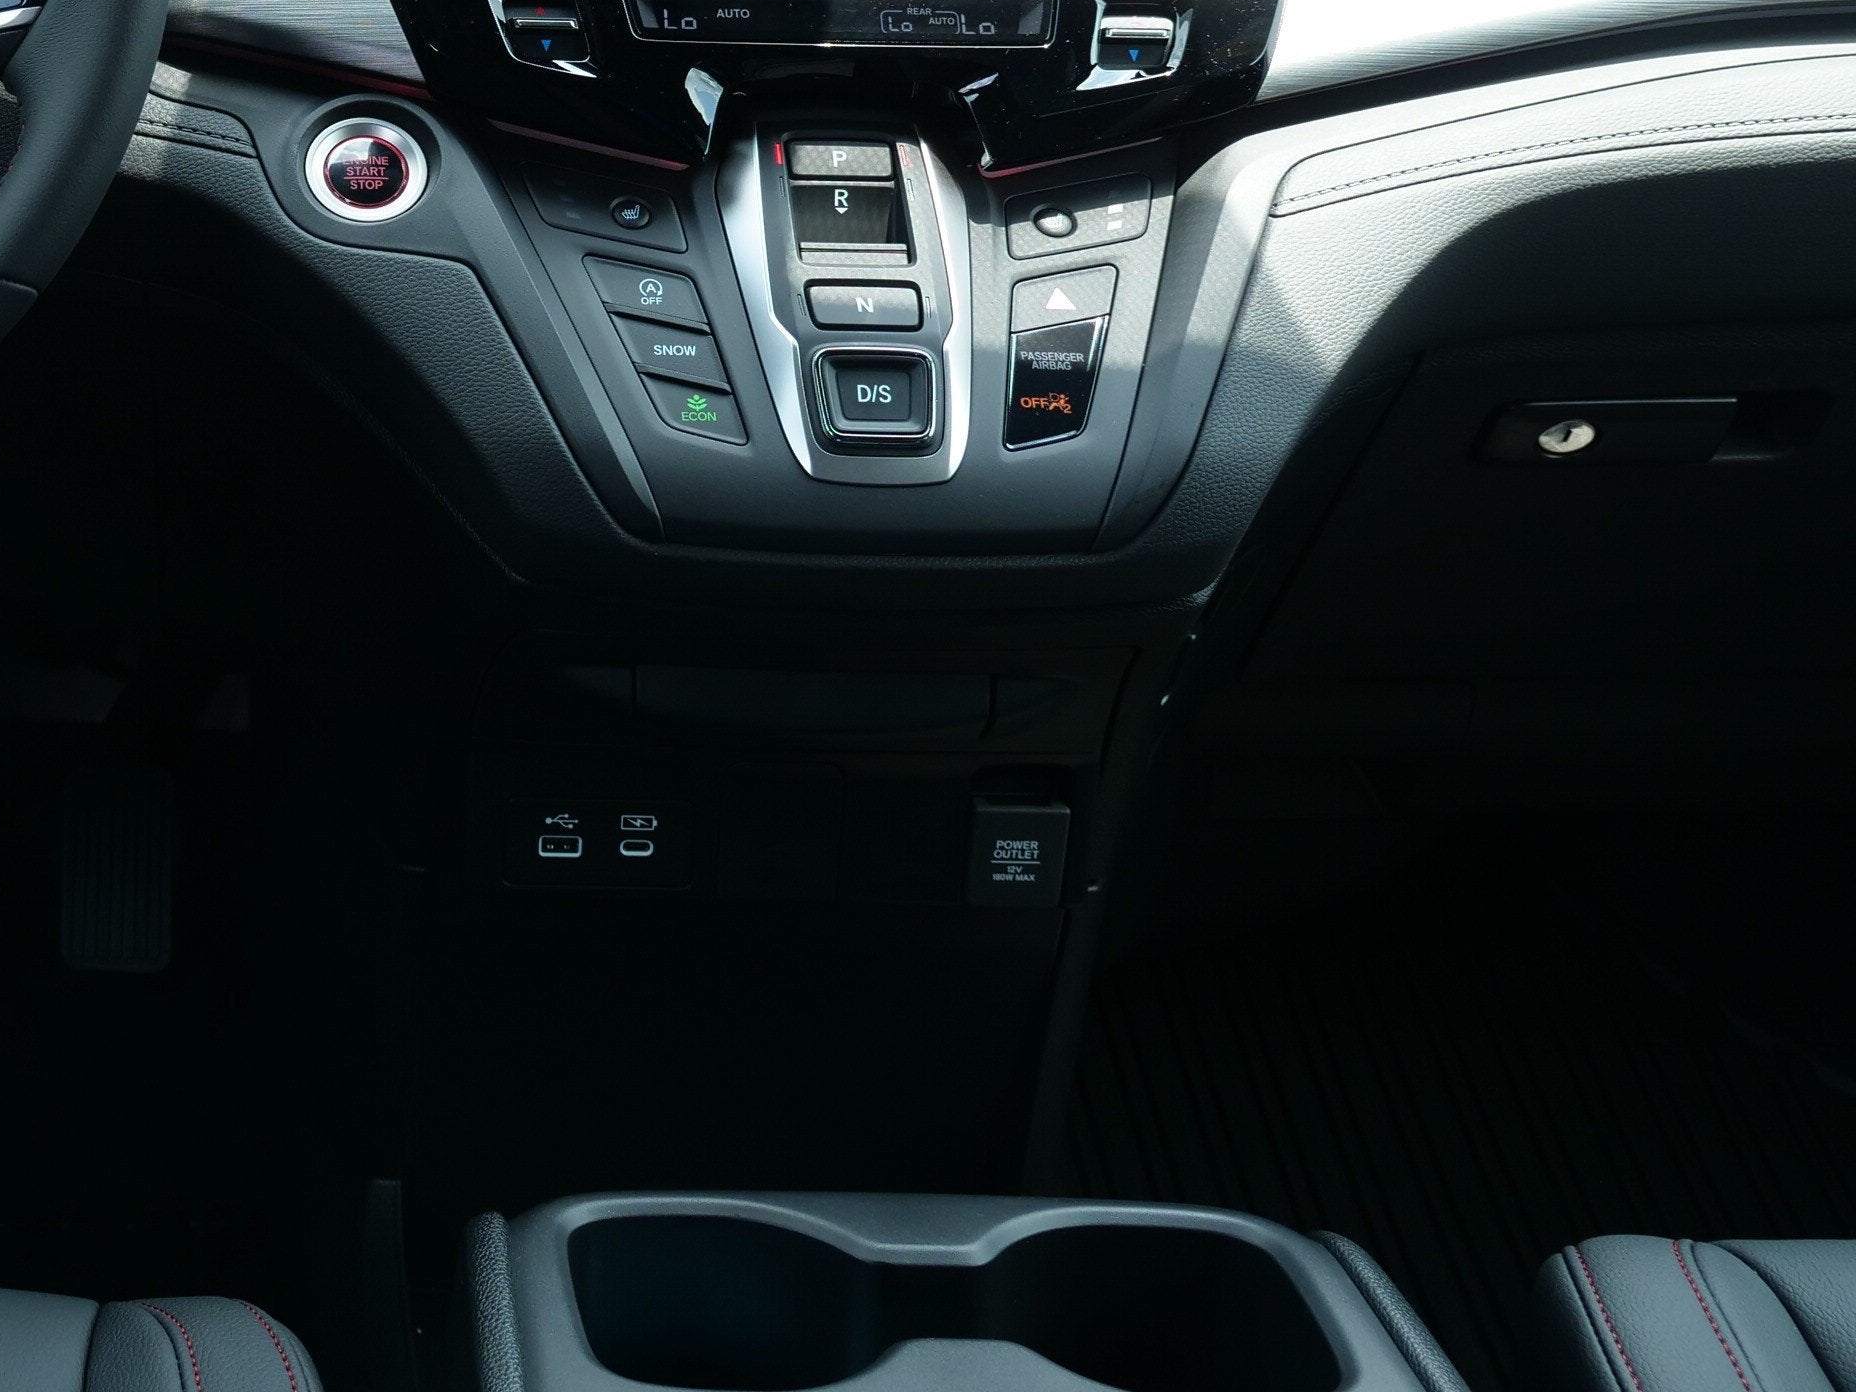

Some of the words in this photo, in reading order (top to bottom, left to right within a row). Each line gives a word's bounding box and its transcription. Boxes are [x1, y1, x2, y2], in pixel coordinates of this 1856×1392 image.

[716, 9, 750, 19] AUTO
[928, 17, 955, 25] AUTO
[343, 156, 389, 165] ENGINE
[832, 151, 847, 167] P
[346, 167, 385, 176] START
[350, 180, 383, 189] STOP
[834, 189, 848, 207] R
[641, 297, 662, 305] OFF
[855, 298, 874, 313] N
[653, 345, 696, 356] SNOW
[1021, 351, 1084, 362] PASSENGER
[1032, 361, 1072, 371] AIRBAG
[857, 385, 892, 403] D/S
[1021, 397, 1048, 408] OFF
[681, 412, 717, 422] ECON
[996, 840, 1038, 850] POWER
[994, 850, 1039, 859] OUTLET
[1007, 865, 1023, 873] 12V
